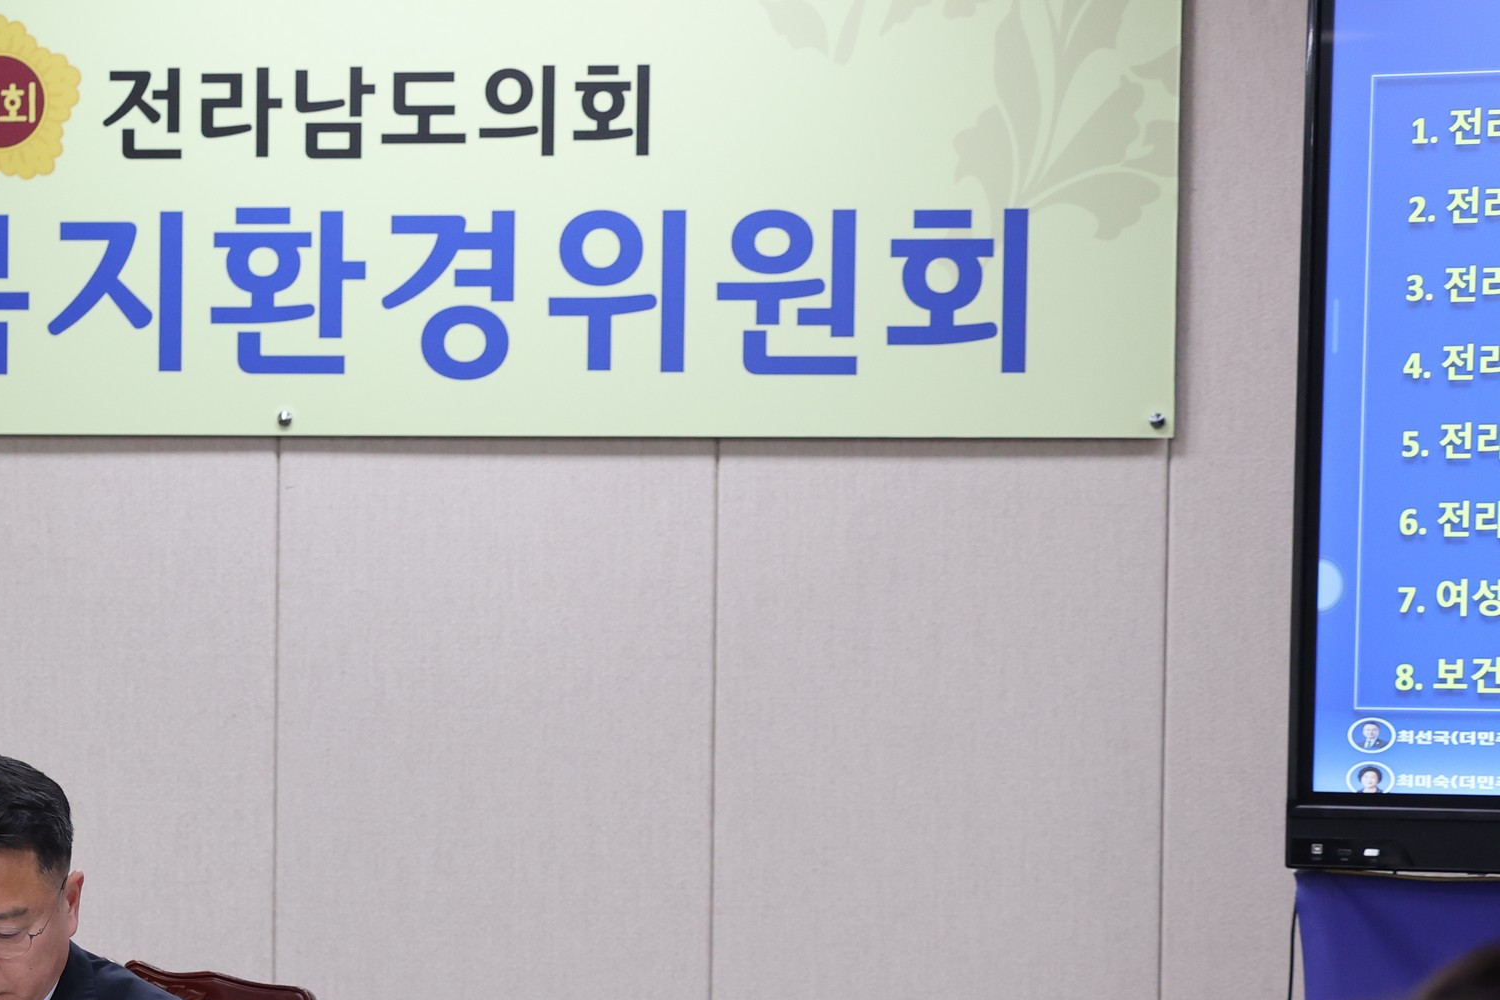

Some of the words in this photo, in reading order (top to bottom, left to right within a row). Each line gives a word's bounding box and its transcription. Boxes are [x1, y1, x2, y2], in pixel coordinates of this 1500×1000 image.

[104, 64, 650, 160] 전라남도의회
[1412, 117, 1438, 144] 1.
[1408, 196, 1436, 223] 2.
[1406, 274, 1433, 302] 3.
[1403, 352, 1431, 380] 4.
[1402, 430, 1429, 458] 5.
[1400, 508, 1427, 536] 6.
[1398, 586, 1425, 613] 7.
[1395, 663, 1423, 691] 8.
[1396, 729, 1500, 746] 최선국(더민
[1396, 773, 1500, 790] 최미숙(더민
